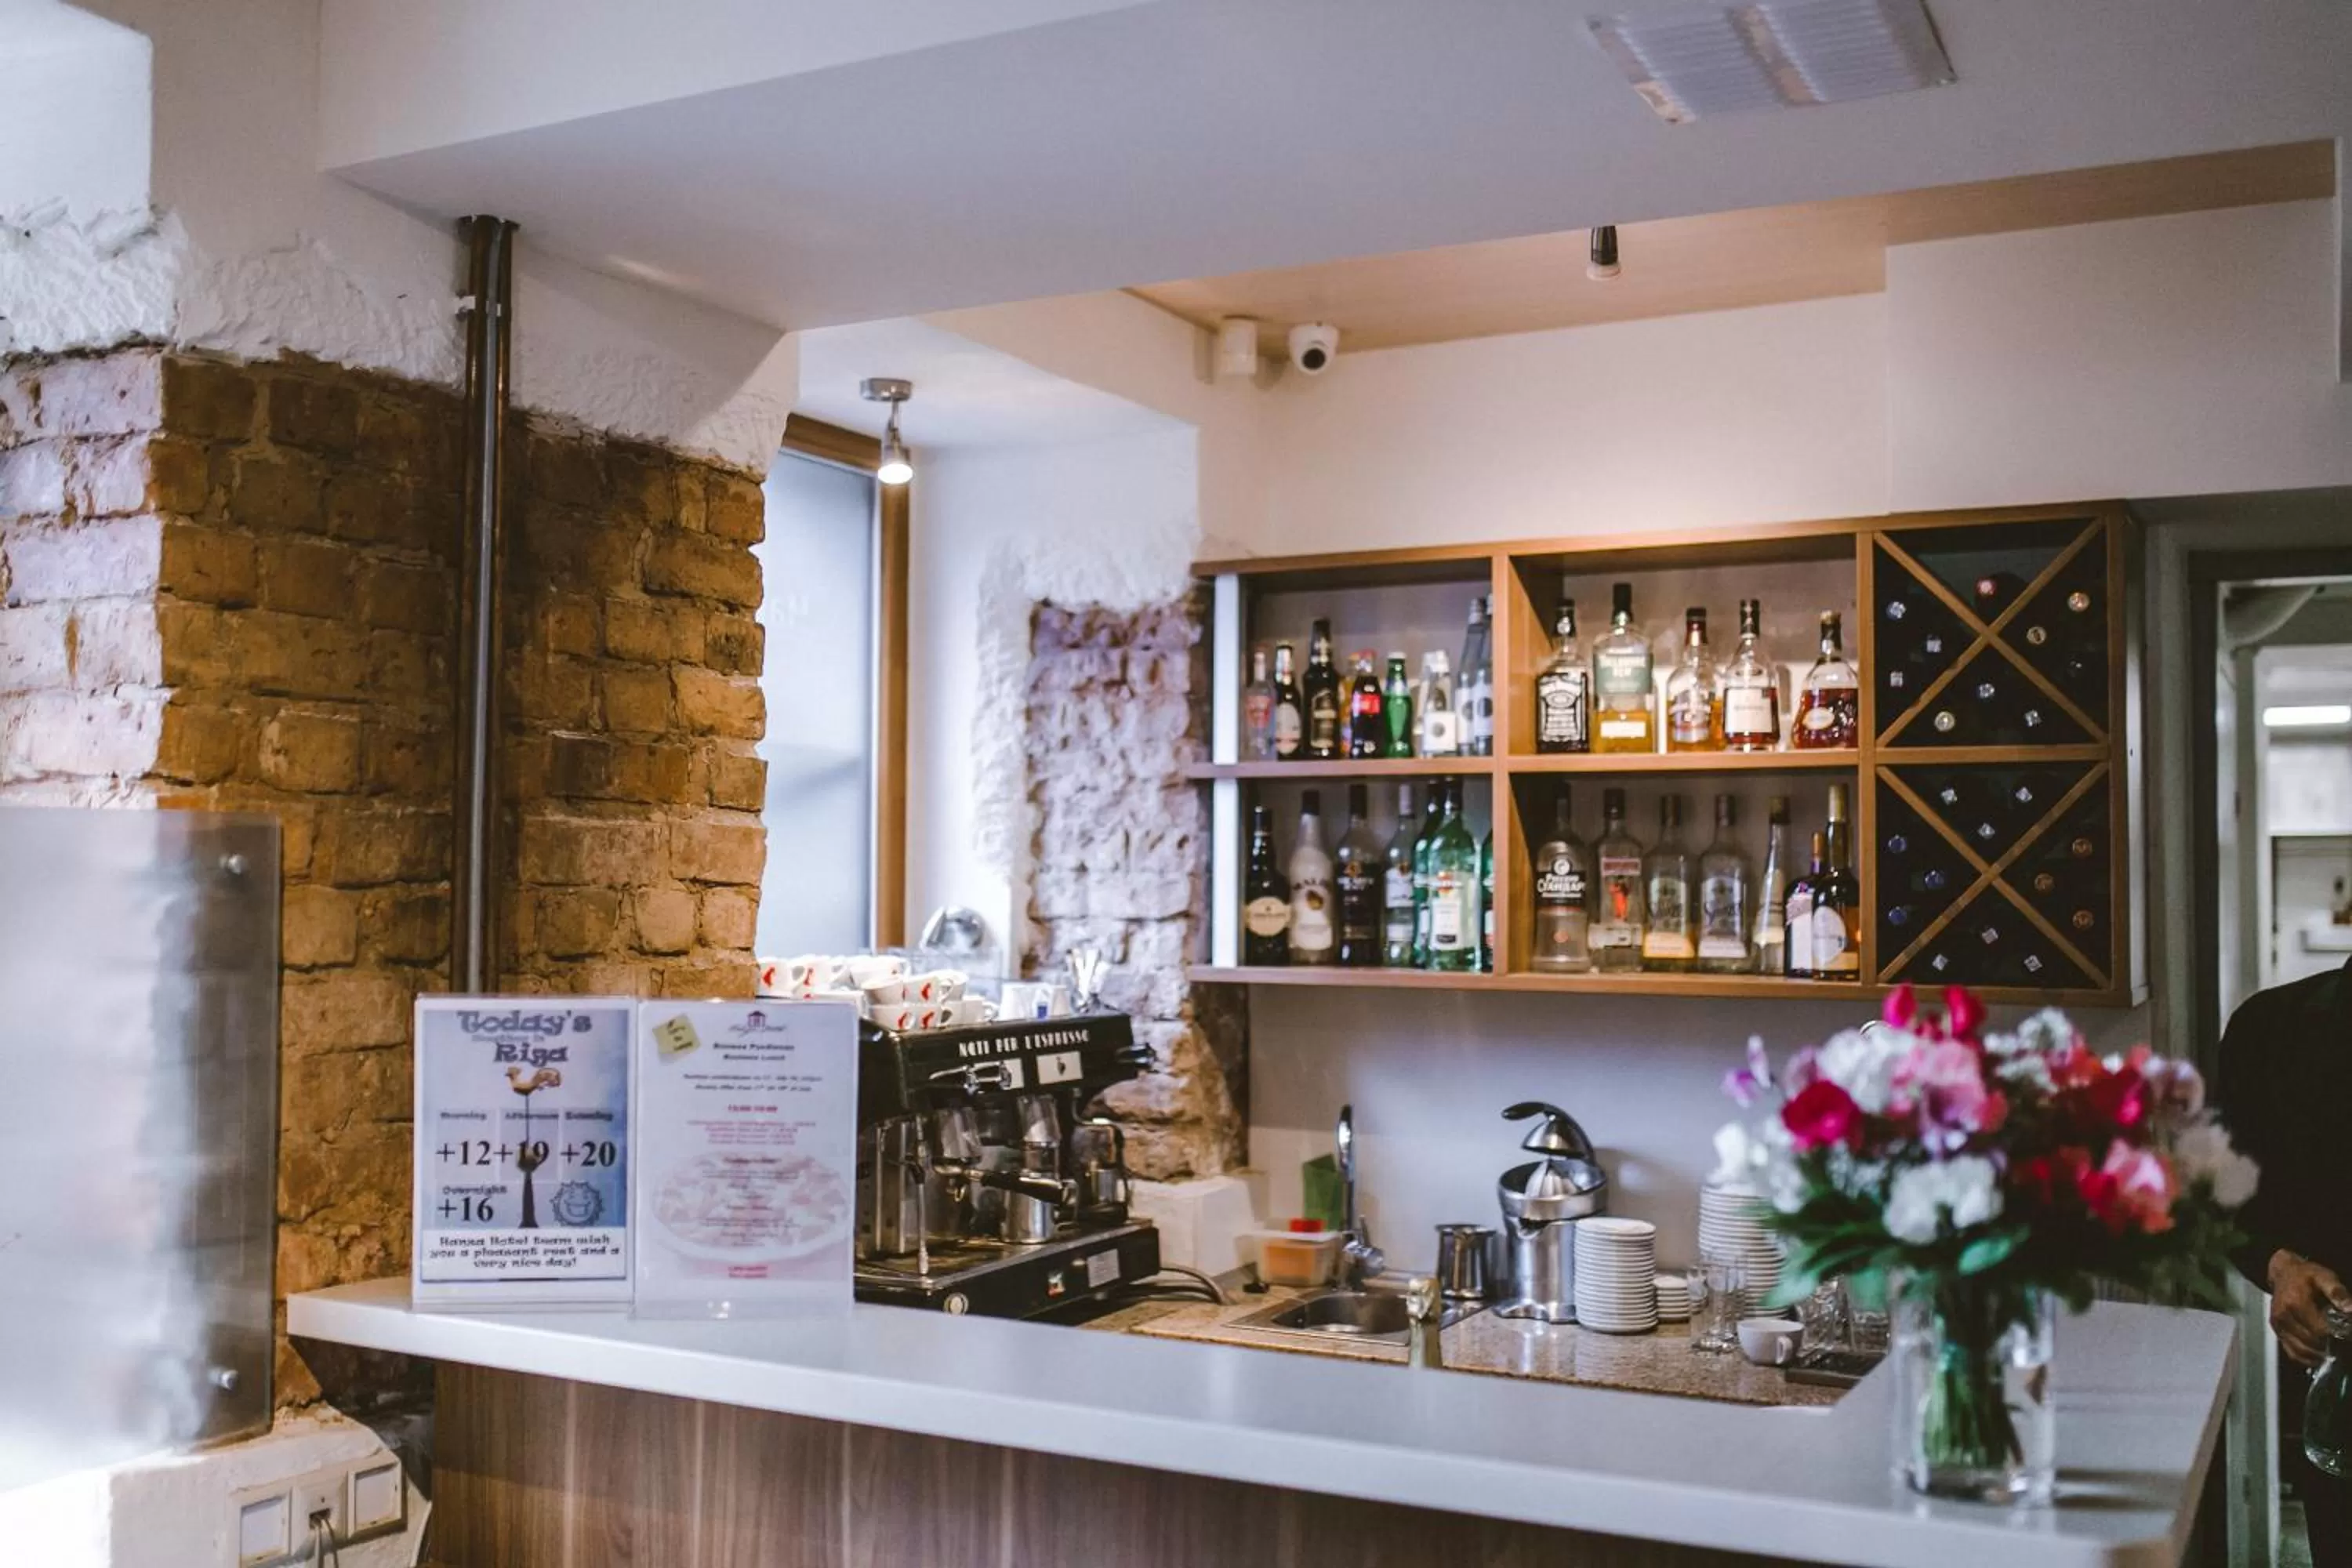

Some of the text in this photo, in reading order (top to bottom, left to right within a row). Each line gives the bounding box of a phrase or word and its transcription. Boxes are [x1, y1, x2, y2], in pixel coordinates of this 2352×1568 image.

[457, 1009, 593, 1036] Today's
[493, 1043, 569, 1068] Riga
[436, 1141, 492, 1166] +12
[493, 1141, 550, 1166] +19
[561, 1141, 617, 1167] +20
[437, 1196, 495, 1222] +16
